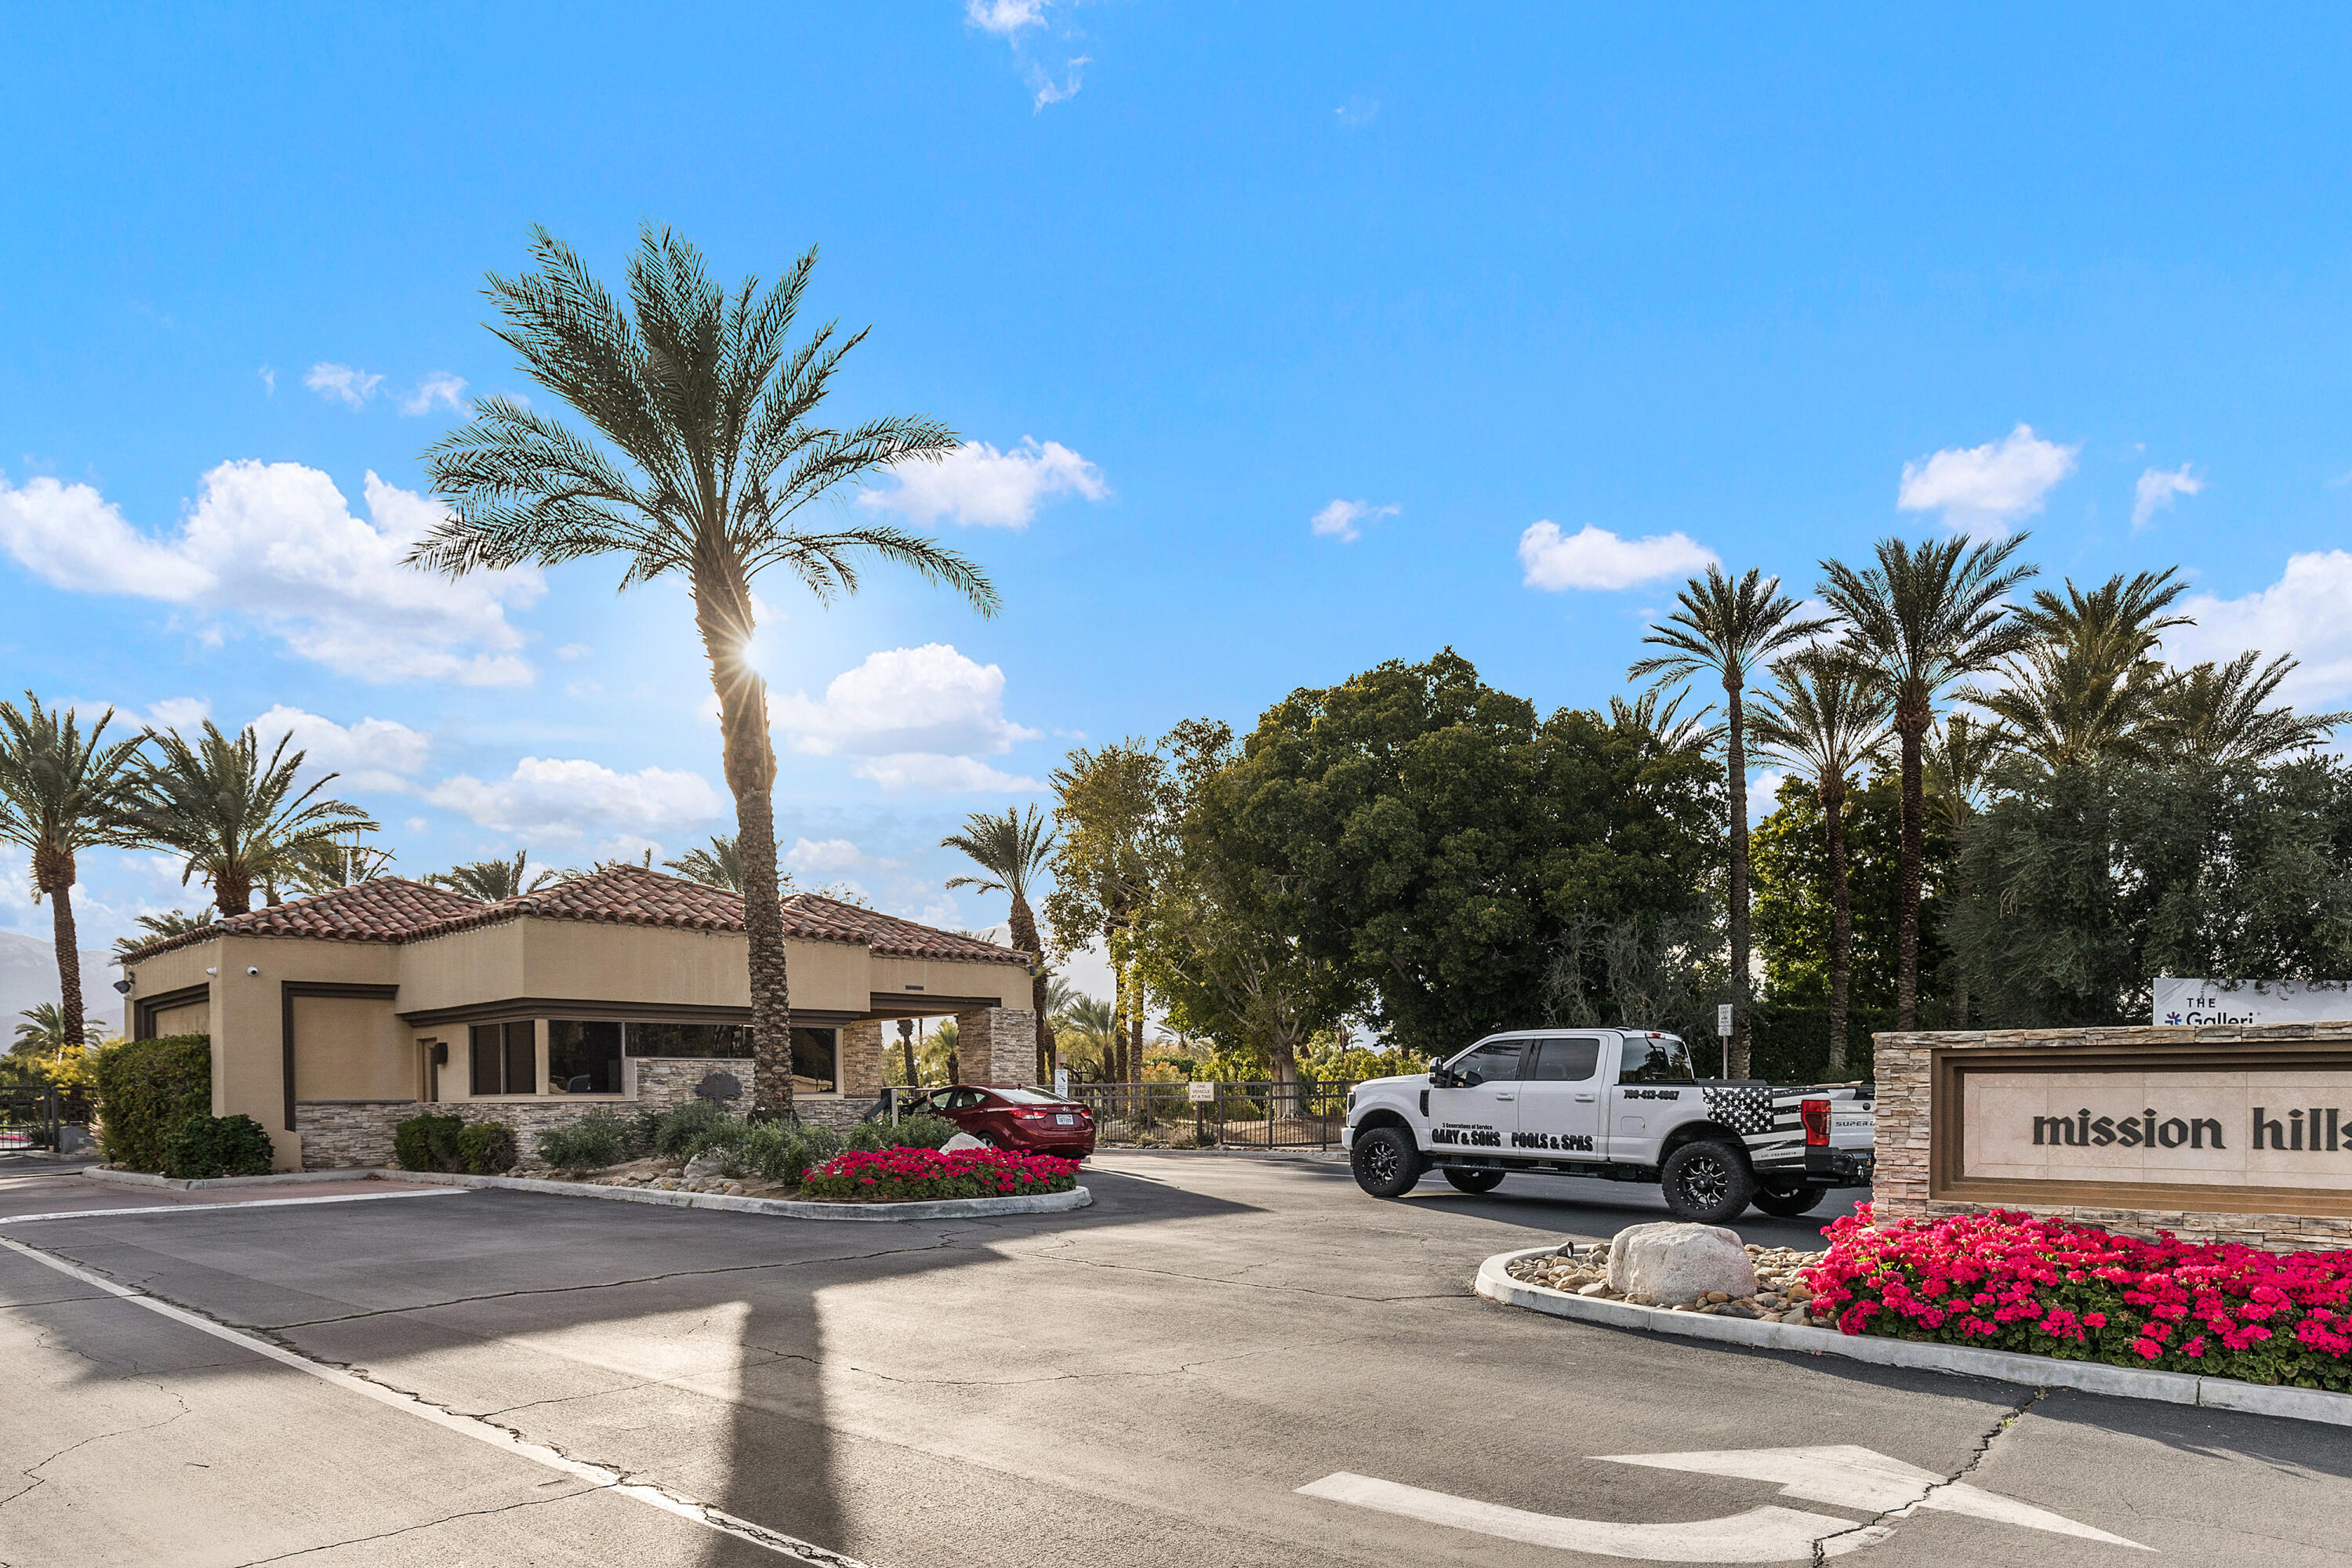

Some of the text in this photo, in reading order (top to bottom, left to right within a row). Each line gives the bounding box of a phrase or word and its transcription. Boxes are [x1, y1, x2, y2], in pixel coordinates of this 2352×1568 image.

[2187, 997, 2216, 1008] THE
[2186, 1011, 2253, 1025] Galleri
[2032, 1107, 2227, 1149] mission
[1432, 1128, 1593, 1152] GARY & SONS POOLS & SPAS
